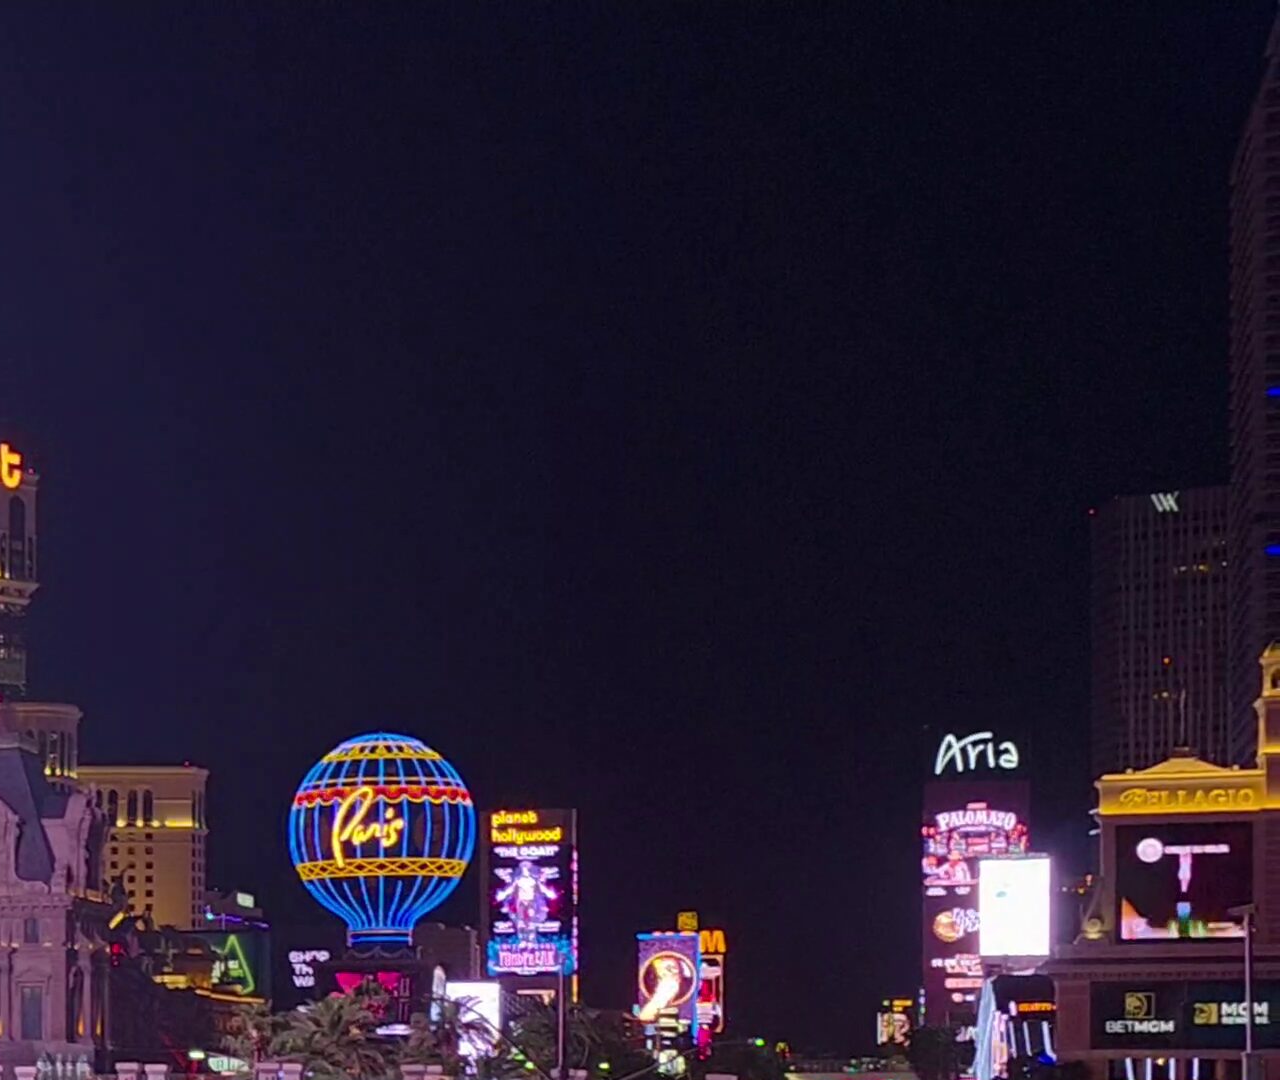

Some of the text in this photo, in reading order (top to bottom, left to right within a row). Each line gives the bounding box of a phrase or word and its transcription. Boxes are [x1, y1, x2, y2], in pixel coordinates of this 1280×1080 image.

[934, 731, 1019, 775] Aria
[1120, 788, 1254, 808] BELLAGIO
[331, 786, 404, 868] Paris
[491, 810, 538, 828] planet
[491, 827, 562, 845] hollywood
[1105, 1020, 1175, 1034] BETMGM
